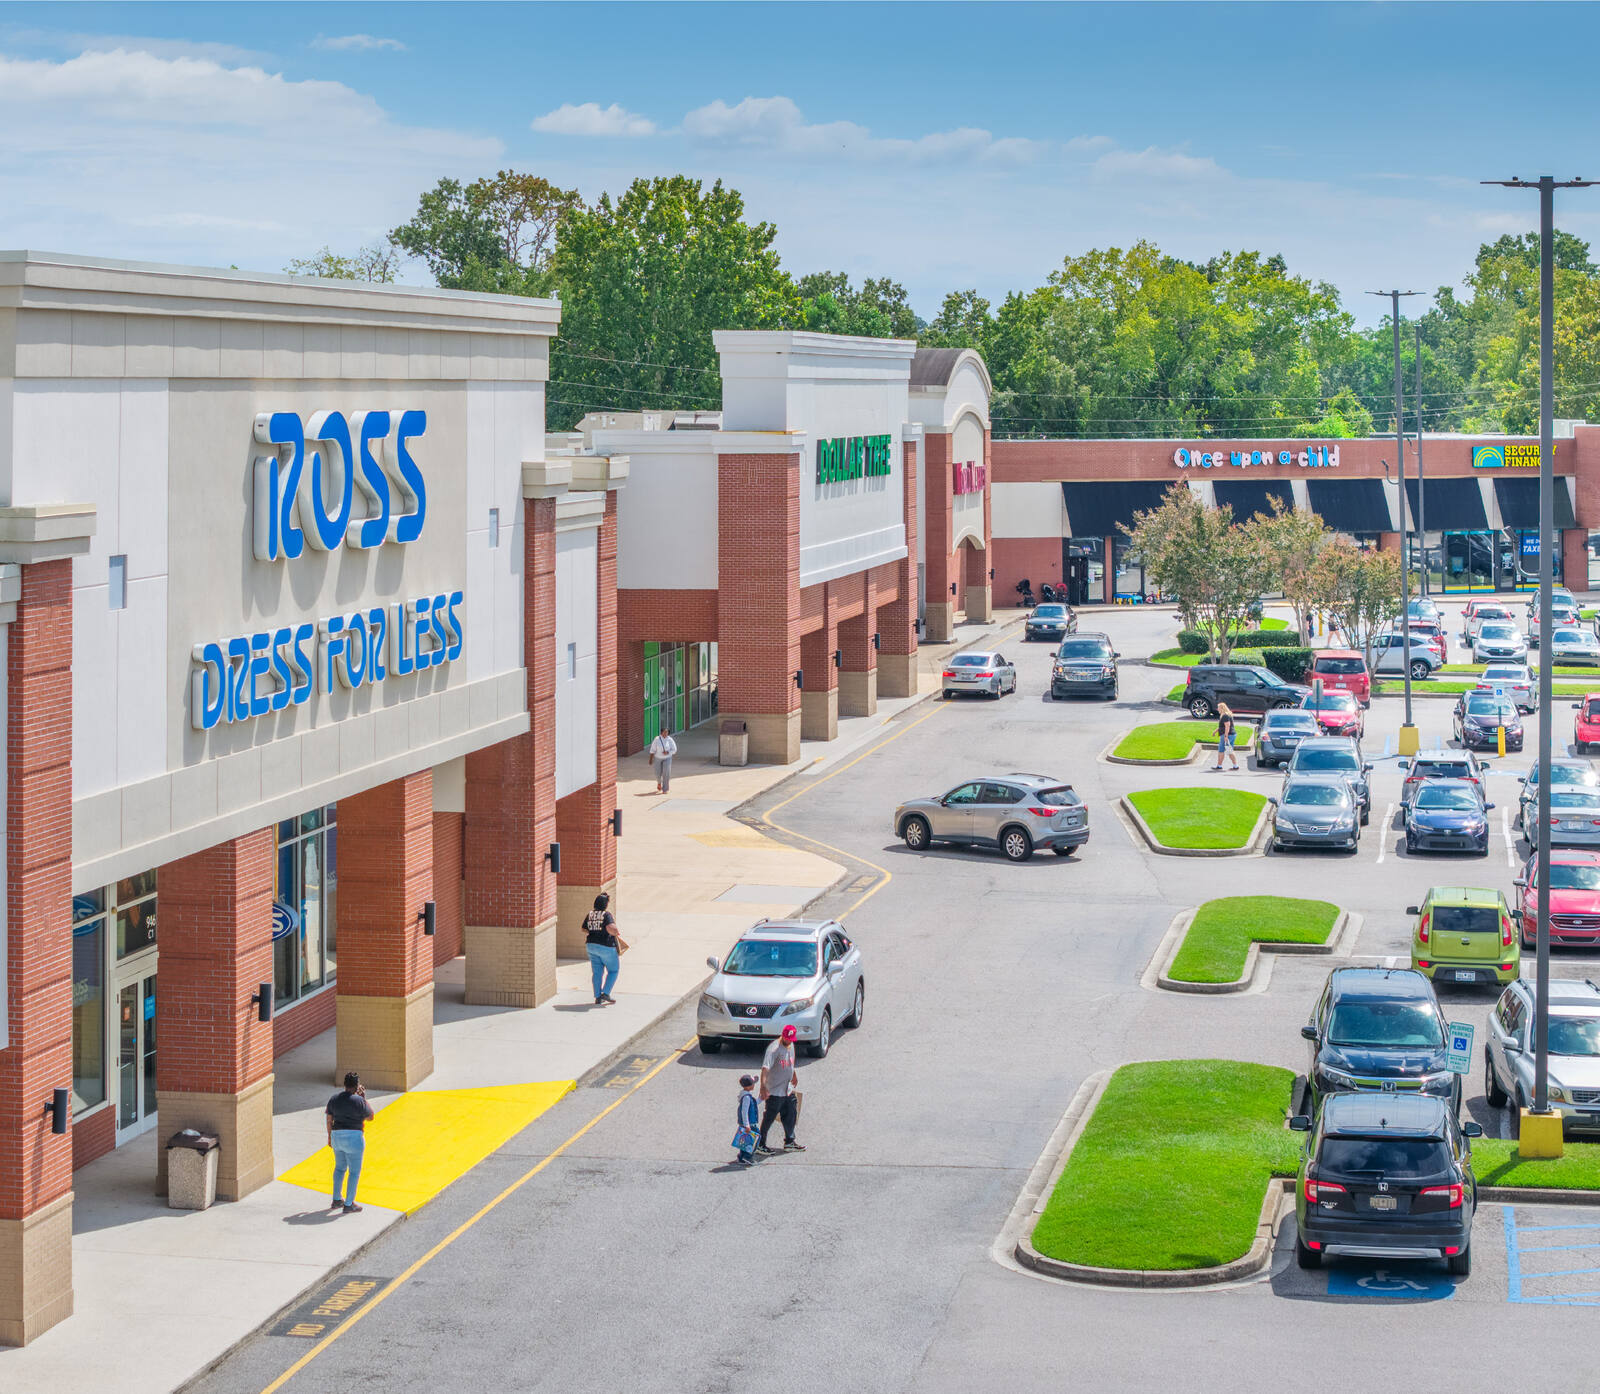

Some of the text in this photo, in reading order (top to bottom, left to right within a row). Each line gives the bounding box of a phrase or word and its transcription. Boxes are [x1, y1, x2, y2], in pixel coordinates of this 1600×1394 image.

[816, 433, 891, 485] DOLLAR TREE
[1173, 445, 1340, 469] Once upon a child
[1504, 445, 1557, 456] SECURY
[255, 409, 427, 562] ROSS
[194, 591, 463, 730] DRESS FOR LESS
[286, 1281, 377, 1336] NO PARKING
